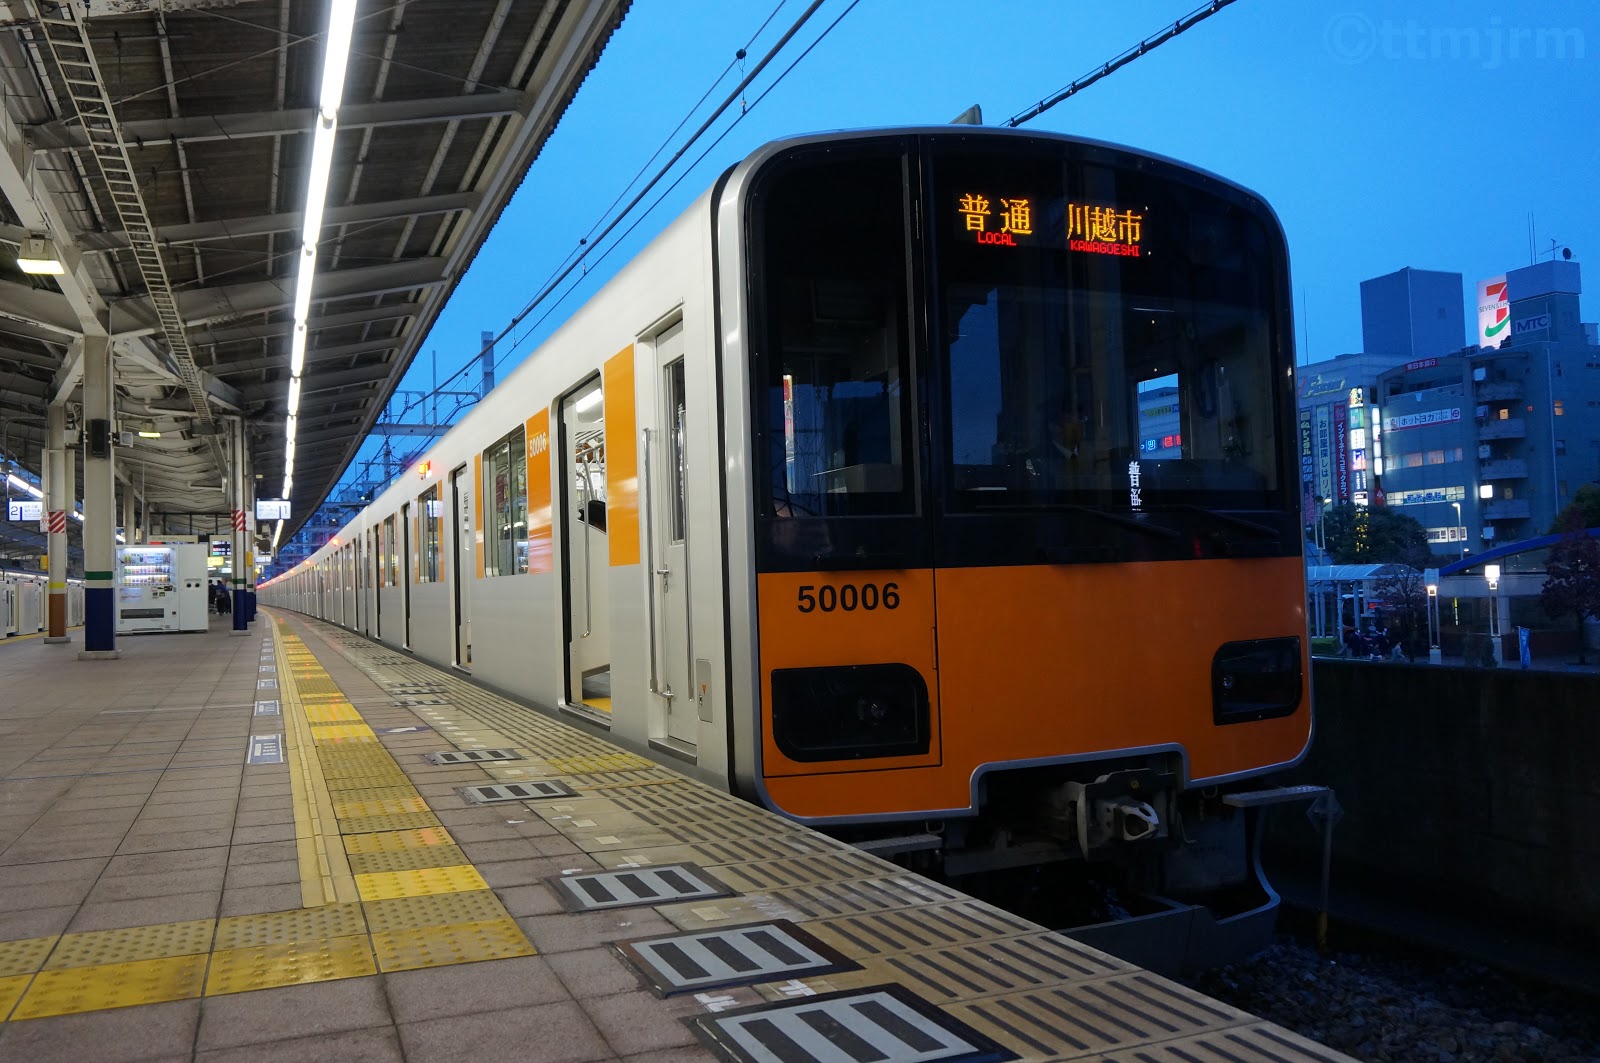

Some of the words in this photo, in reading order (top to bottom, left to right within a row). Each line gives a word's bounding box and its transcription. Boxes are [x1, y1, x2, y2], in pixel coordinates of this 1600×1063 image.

[958, 193, 1033, 235] 普通
[1067, 203, 1143, 245] 川越市
[977, 231, 1017, 247] LOCAL
[1070, 239, 1140, 257] KAWAGOESHI
[1517, 315, 1548, 332] MTC
[10, 506, 19, 516] 2
[797, 582, 901, 613] 50006
